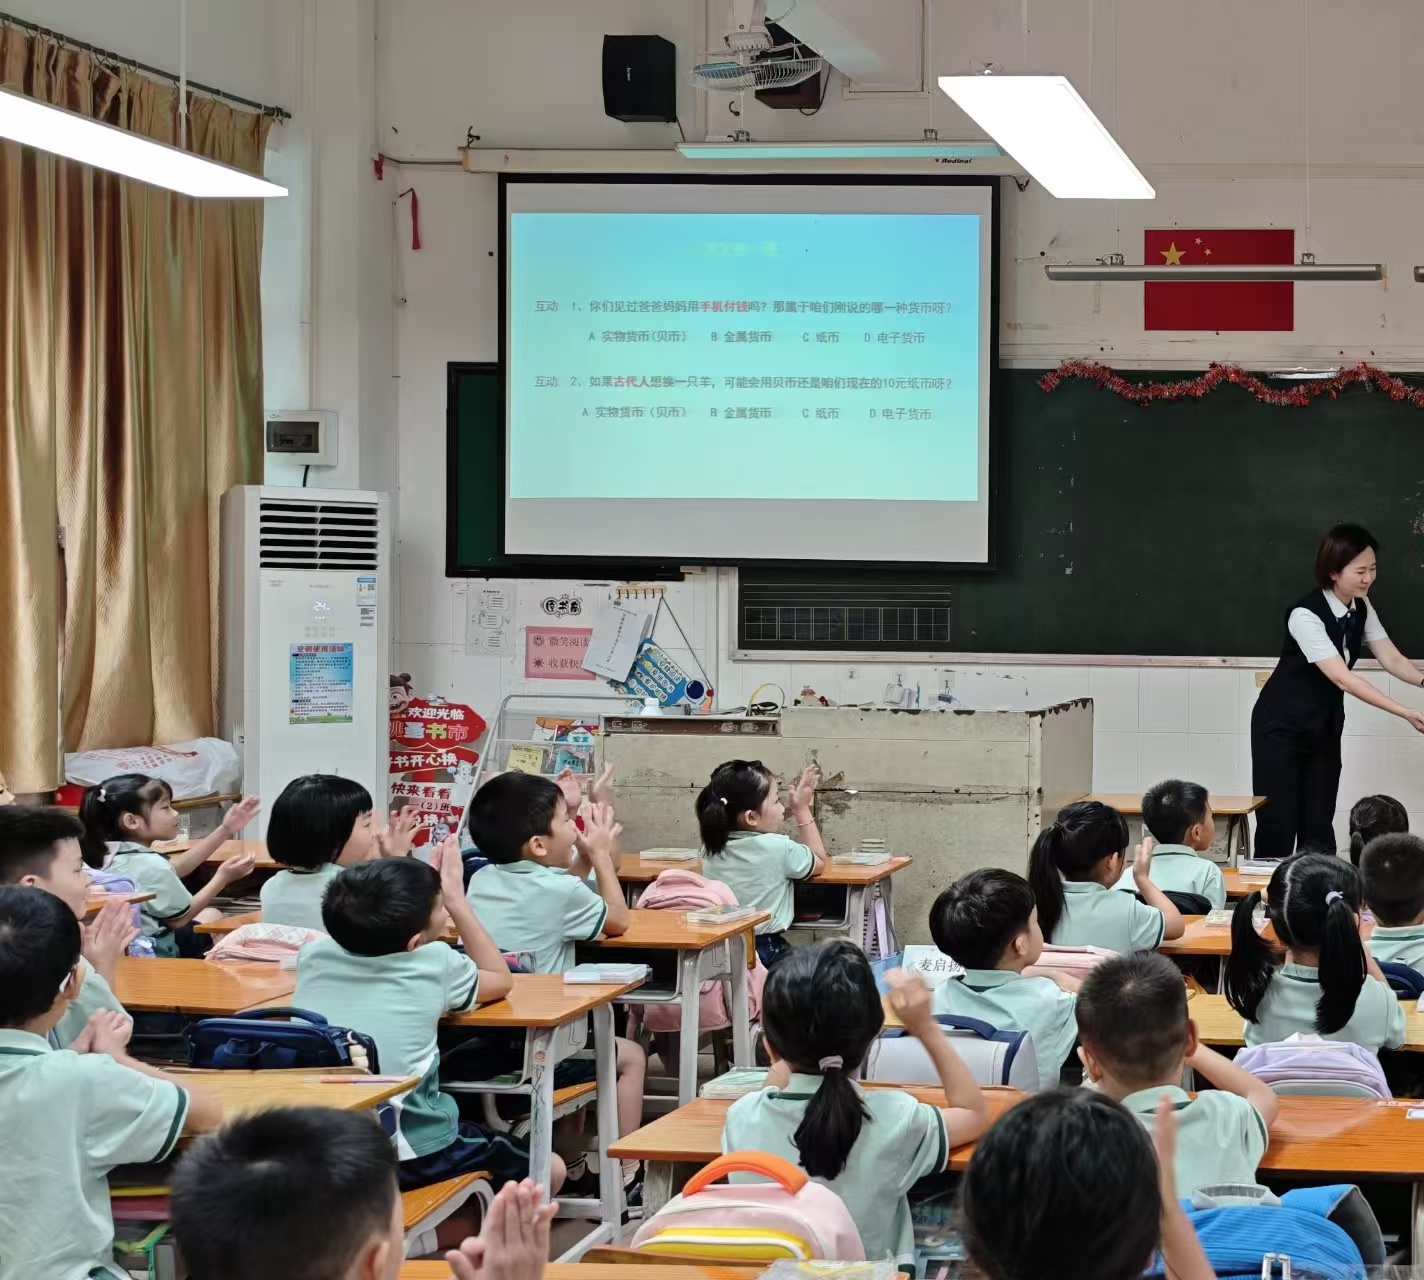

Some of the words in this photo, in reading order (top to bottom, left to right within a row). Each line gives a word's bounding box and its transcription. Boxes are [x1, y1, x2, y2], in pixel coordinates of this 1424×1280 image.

[535, 300, 558, 312] 互动
[589, 332, 595, 341] A
[711, 332, 717, 341] B
[724, 331, 771, 343] 金属货币
[803, 332, 809, 342] C
[816, 332, 839, 343] 纸币
[864, 333, 870, 342] D
[878, 332, 925, 344] 电子货币
[535, 376, 558, 388] 互动
[582, 408, 588, 417] A
[711, 408, 717, 417] B
[724, 407, 771, 419] 金属货币
[803, 408, 809, 418] C
[816, 408, 839, 420] 纸币
[870, 409, 876, 418] D
[882, 408, 931, 420] 电子货币
[314, 601, 326, 611] 24
[549, 656, 584, 669] 收获快
[407, 706, 465, 721] 欢迎光临
[390, 752, 458, 769] 书开心换
[390, 781, 452, 800] 快来看看
